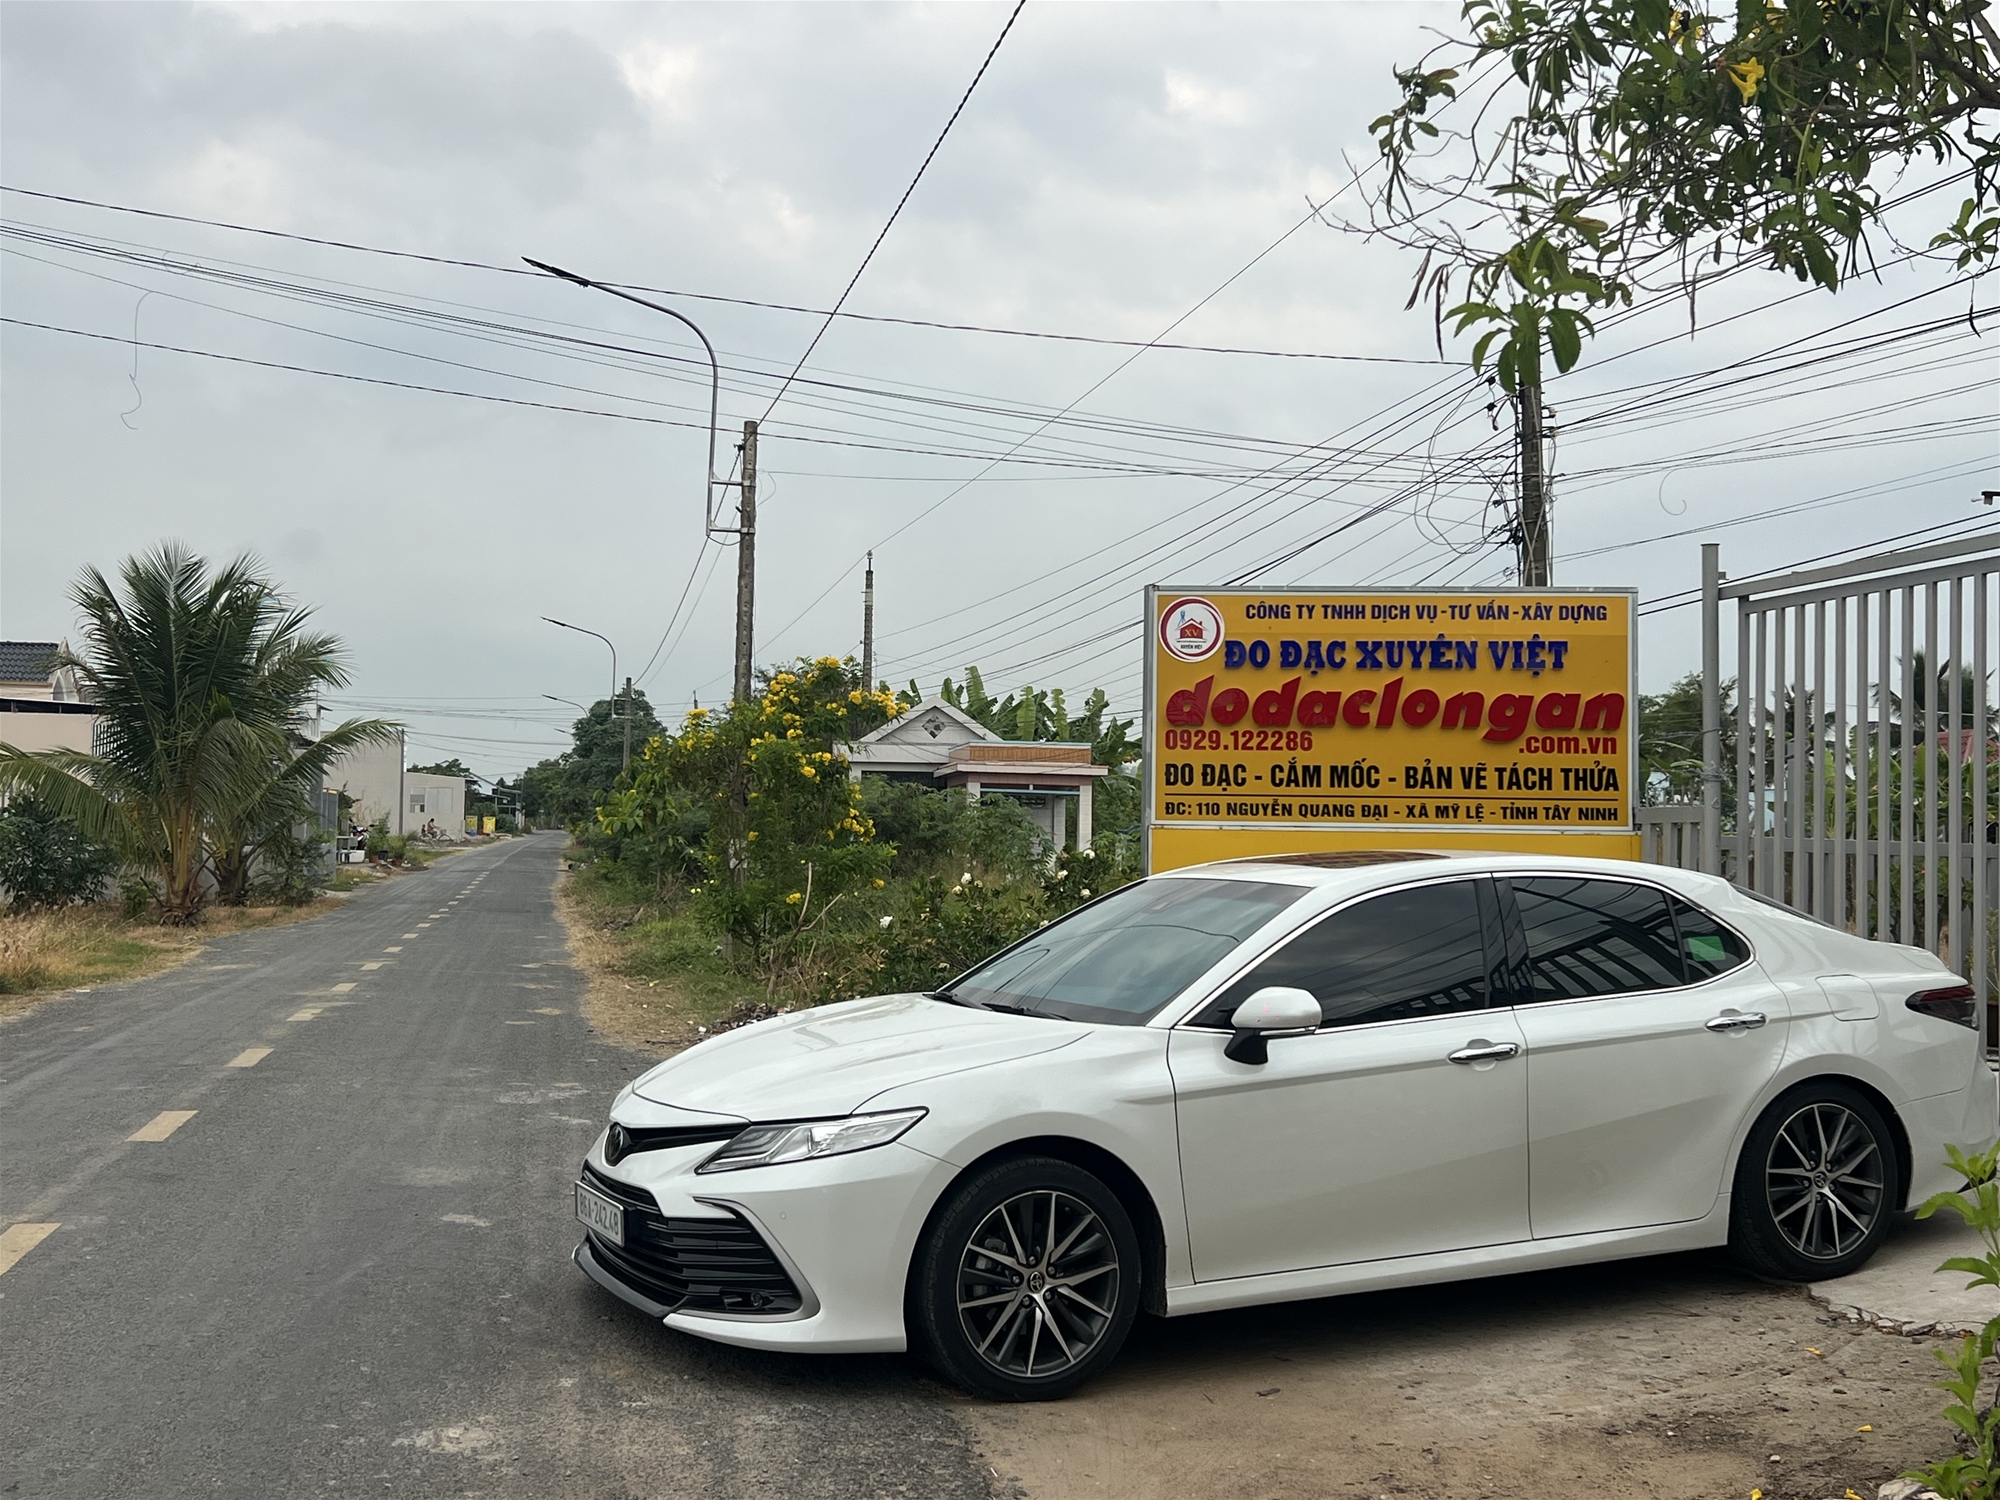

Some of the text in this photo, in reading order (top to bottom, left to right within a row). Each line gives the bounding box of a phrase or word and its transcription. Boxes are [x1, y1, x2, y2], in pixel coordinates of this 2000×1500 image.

[1245, 601, 1291, 619] CÔNG
[1296, 604, 1315, 619] TY
[1321, 604, 1366, 619] TNHH
[1371, 605, 1410, 623] DỊCH
[1558, 603, 1607, 624] DỰNG
[1185, 629, 1199, 637] XV
[1224, 633, 1569, 677] ĐO ĐẠC XUYÊN VIỆT
[1165, 675, 1625, 743] dodaclongan
[1165, 729, 1313, 751] 0929.122286
[1519, 736, 1617, 755] .com.vn
[1164, 763, 1194, 787] ĐO
[1201, 763, 1247, 792] ĐẠC
[1270, 757, 1321, 788] CẮM
[1330, 758, 1380, 789] MỐC
[1405, 758, 1452, 790] BẢN
[1460, 762, 1487, 790] VẼ
[1494, 762, 1553, 791] TÁCH
[1560, 760, 1619, 791] THỬA
[1165, 802, 1192, 816] ĐC:
[1196, 802, 1220, 816] 110
[1227, 798, 1293, 817] NGUYỄN
[1299, 803, 1355, 818] QUANG
[1361, 804, 1388, 820] ĐẠI
[1406, 803, 1429, 819] XÃ
[1435, 803, 1460, 819] MỸ
[1466, 803, 1484, 822] LỆ
[1500, 802, 1538, 820] TỈNH
[1543, 804, 1571, 820] TÂY
[1578, 807, 1618, 821] NINH
